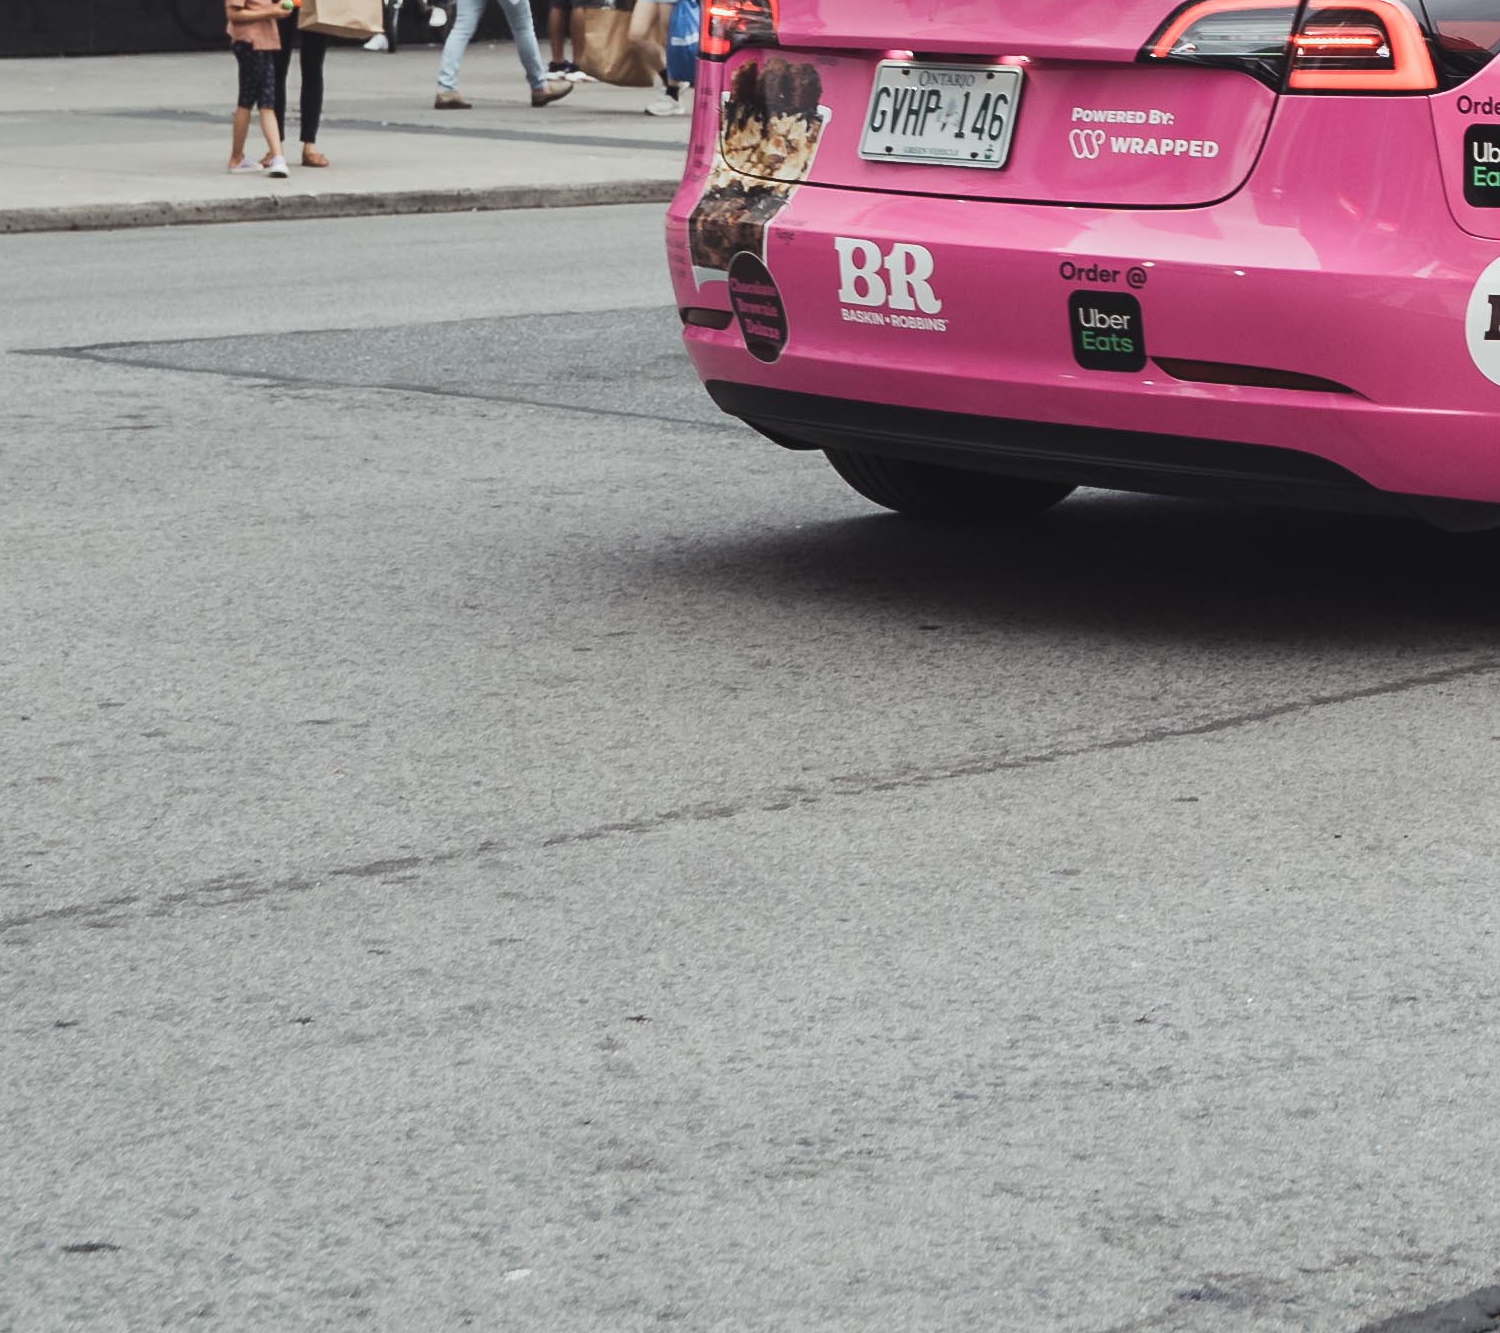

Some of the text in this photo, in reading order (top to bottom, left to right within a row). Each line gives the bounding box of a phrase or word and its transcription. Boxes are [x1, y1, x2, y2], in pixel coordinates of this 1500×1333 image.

[870, 86, 1010, 142] GVHP 146
[1109, 137, 1220, 158] WRAPPED
[834, 236, 942, 315] BR
[1059, 261, 1147, 289] Order @
[1078, 307, 1131, 330] Uber
[1082, 331, 1134, 353] Eats
